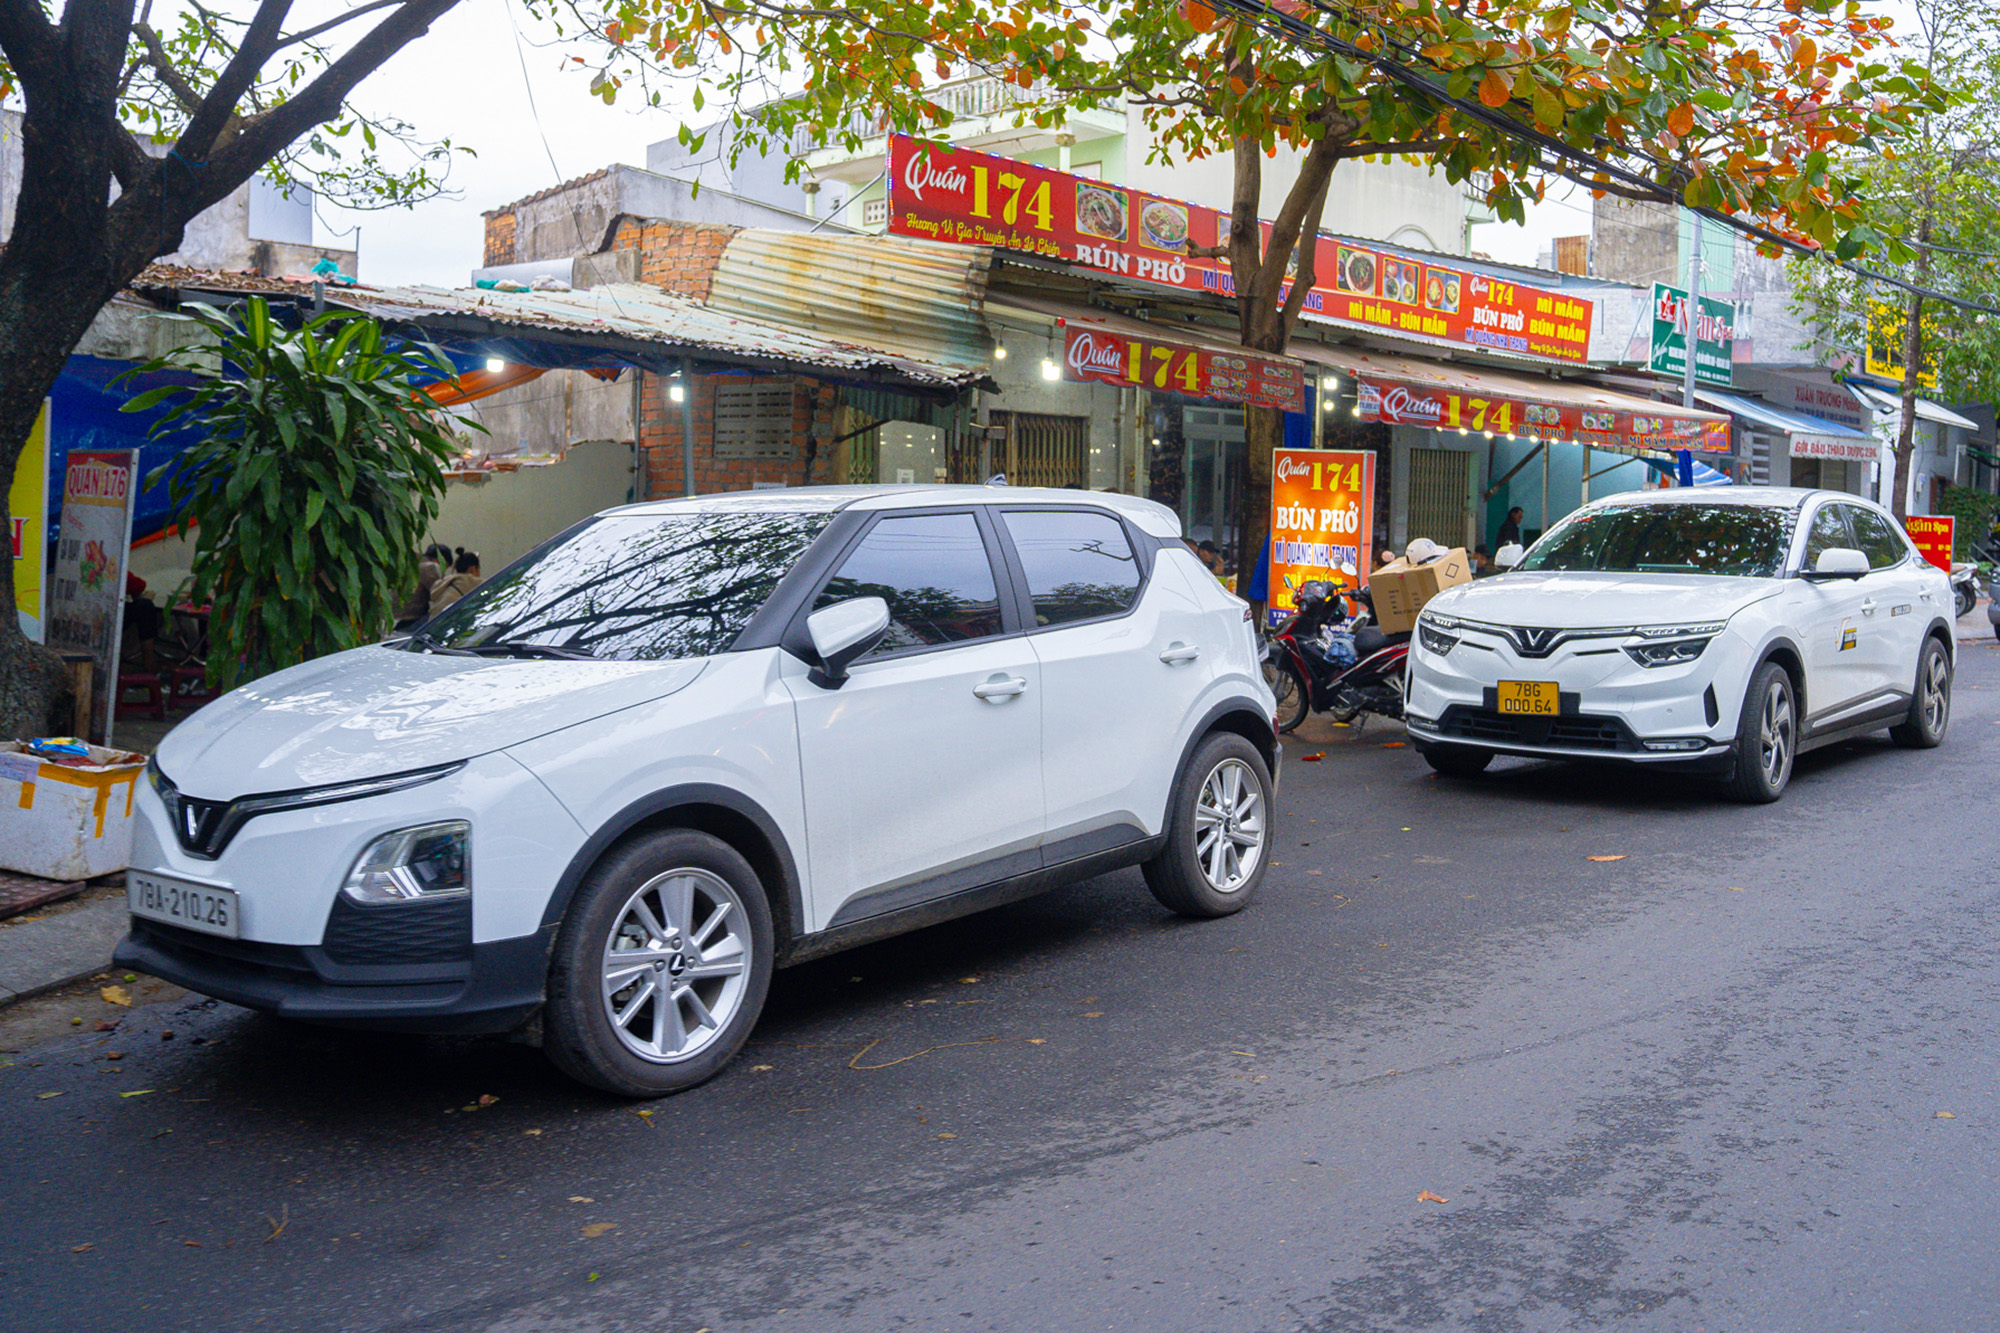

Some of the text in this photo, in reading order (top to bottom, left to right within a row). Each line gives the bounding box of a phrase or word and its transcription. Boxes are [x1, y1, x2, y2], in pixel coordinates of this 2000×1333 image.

[905, 150, 1054, 232] Quán 174
[956, 222, 972, 242] Gia
[1075, 243, 1130, 276] BÚN
[1136, 255, 1186, 286] PHỞ
[1202, 268, 1218, 290] MÌ
[1470, 276, 1514, 306] Quán 174
[1349, 300, 1363, 320] MÌ
[1365, 302, 1391, 326] MẮM
[1400, 311, 1421, 331] BÚN
[1422, 313, 1447, 336] MẮM
[1473, 304, 1525, 332] BÚN PHỞ
[1536, 297, 1584, 321] MÌ MẮM
[1529, 318, 1586, 344] BÚN MẮM
[1068, 332, 1201, 392] Quán 174
[1384, 386, 1442, 421] Quán
[1445, 395, 1513, 433] 174
[101, 467, 127, 499] 176
[1277, 456, 1360, 492] Quán 174
[1276, 500, 1359, 534] BÚN PHỞ
[1933, 522, 1949, 535] Spa
[1274, 537, 1285, 563] MÌ
[1286, 535, 1312, 567] QUẢNG
[1313, 543, 1330, 567] NHA
[1504, 698, 1552, 713] 000.64
[1515, 683, 1541, 697] 78G
[136, 880, 229, 927] 78A-210.26
